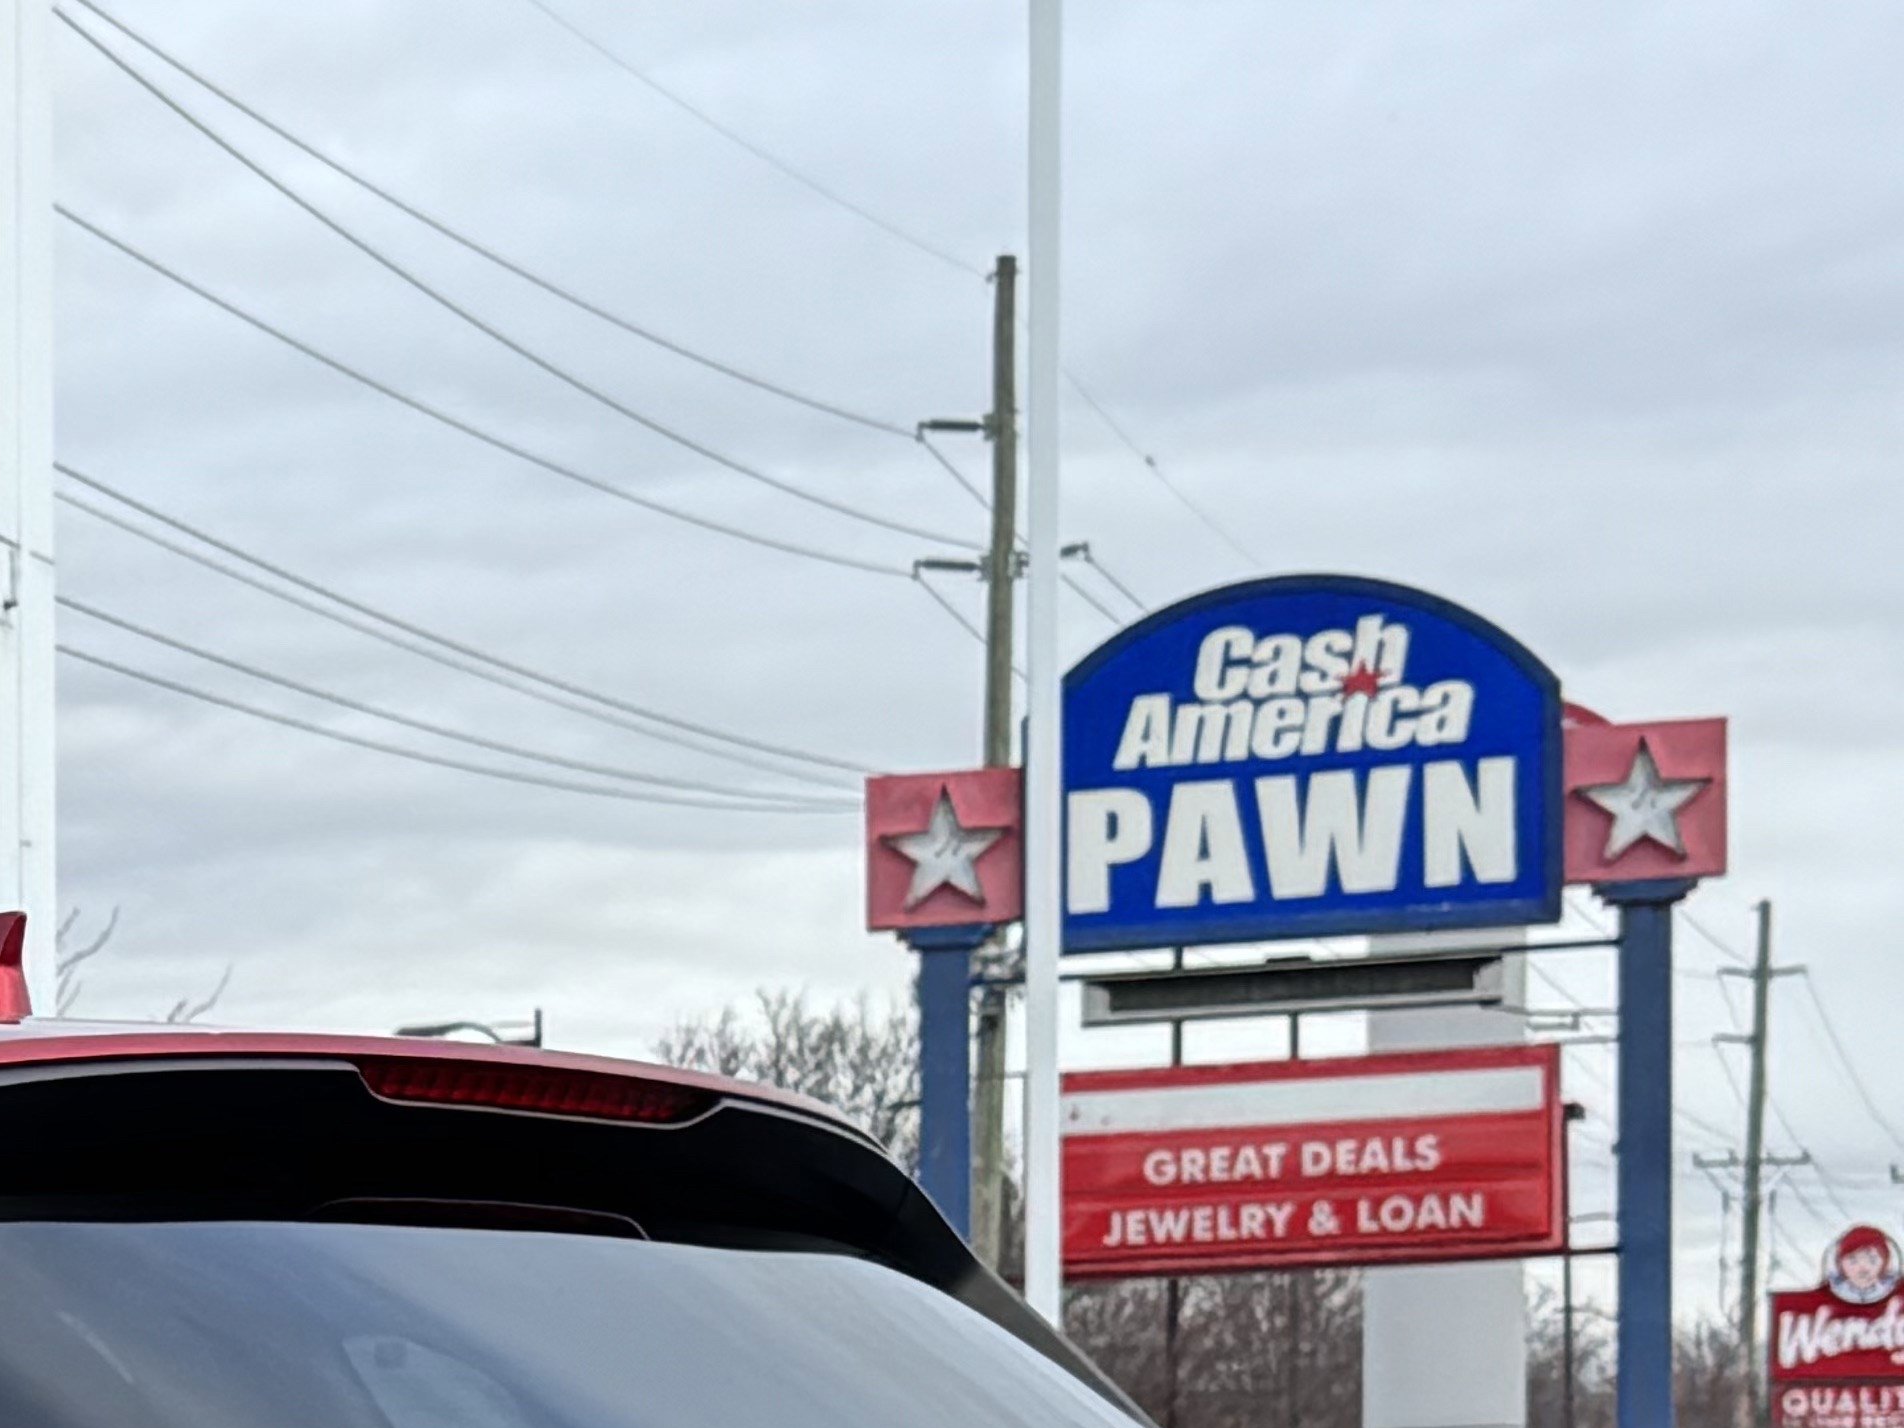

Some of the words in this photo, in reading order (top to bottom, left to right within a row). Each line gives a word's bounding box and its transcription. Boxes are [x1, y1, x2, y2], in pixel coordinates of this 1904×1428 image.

[1193, 613, 1410, 701] Cash
[1112, 679, 1474, 770] America
[1066, 755, 1518, 915] PAWN
[1143, 1142, 1288, 1186] GREAT
[1300, 1133, 1442, 1177] DEALS
[1102, 1203, 1294, 1248] JEWELRY
[1306, 1201, 1341, 1237] &
[1357, 1193, 1485, 1235] LOAN
[1778, 1295, 1904, 1369] Wend
[1782, 1385, 1904, 1418] QUALI
